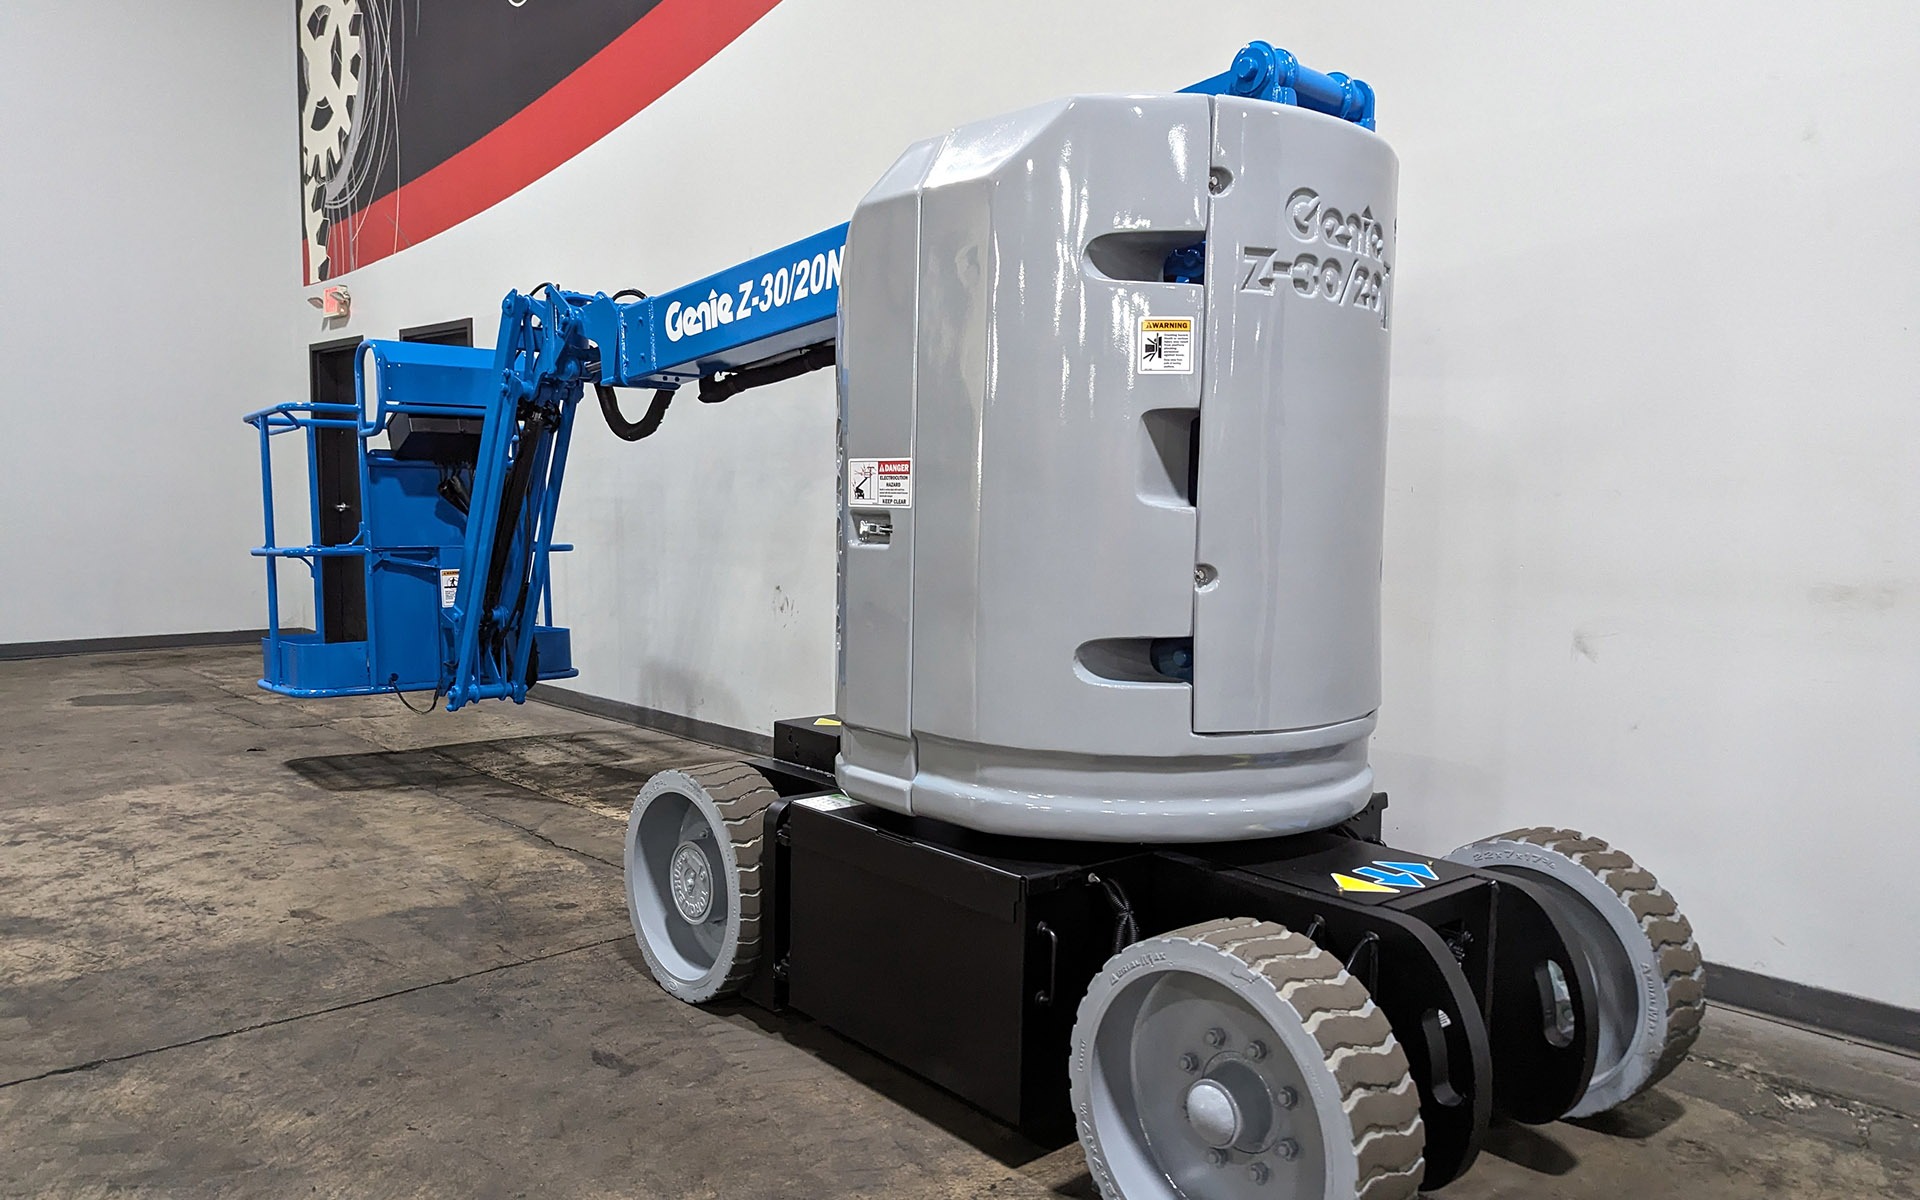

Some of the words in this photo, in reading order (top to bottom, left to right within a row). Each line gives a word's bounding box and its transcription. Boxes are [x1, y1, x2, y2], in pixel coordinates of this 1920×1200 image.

[1285, 187, 1384, 263] Genie
[665, 289, 734, 342] Genie
[736, 245, 845, 320] Z-30/20N
[884, 463, 909, 472] DANGER
